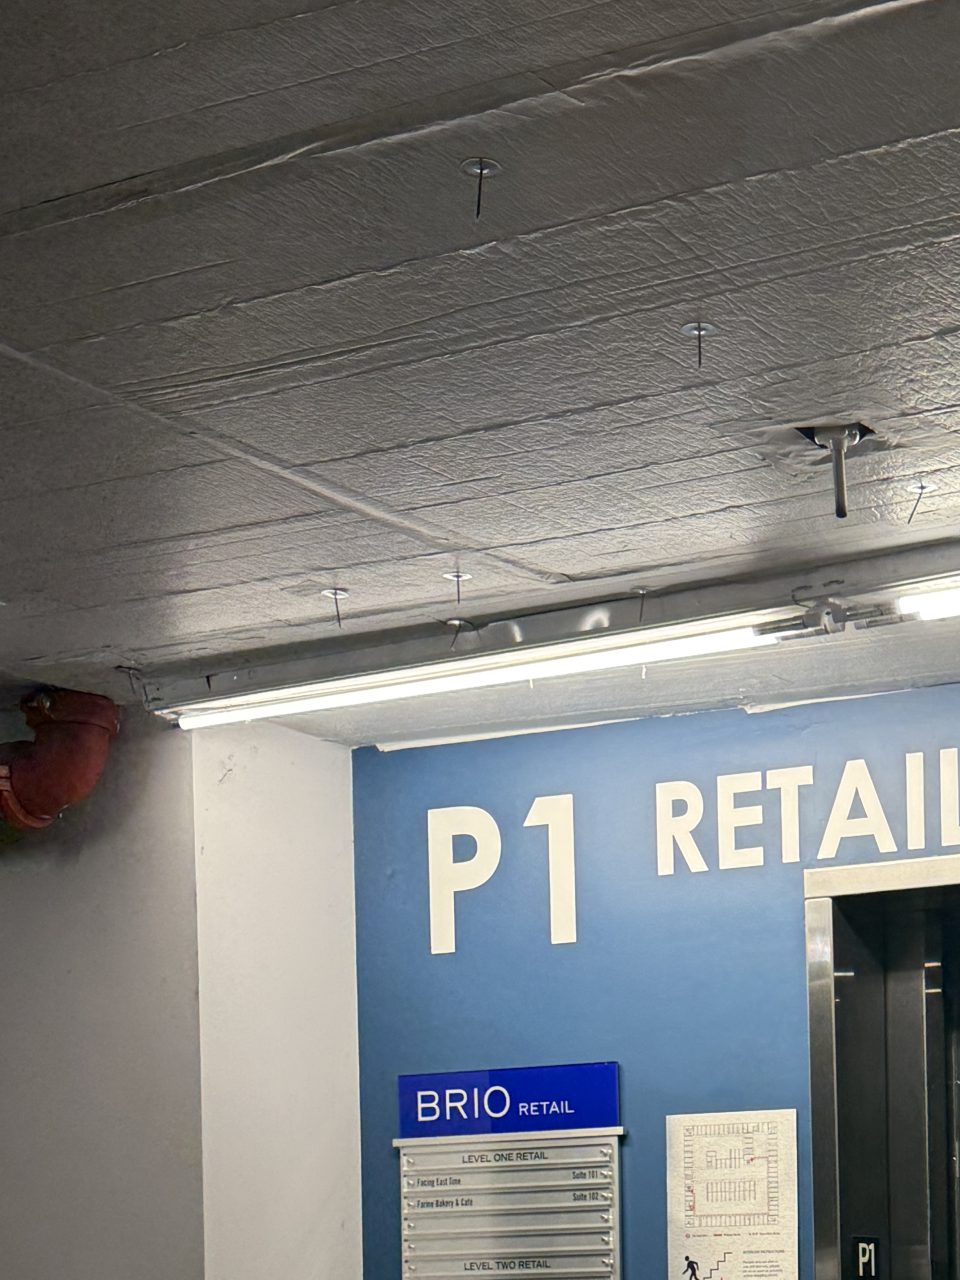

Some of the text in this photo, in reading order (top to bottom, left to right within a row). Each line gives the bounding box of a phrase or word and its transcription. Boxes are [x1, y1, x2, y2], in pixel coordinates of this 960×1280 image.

[416, 1085, 575, 1122] BRIO RETAIL
[462, 1151, 549, 1164] LEVEL ONE RETAIL
[572, 1170, 598, 1180] Suite 101
[417, 1177, 435, 1187] Facing
[436, 1177, 448, 1186] East
[573, 1192, 599, 1201] Suite 102
[435, 1198, 454, 1208] Bakery
[858, 1242, 875, 1277] P1
[464, 1260, 551, 1271] LEVEL TWO RETAIL
